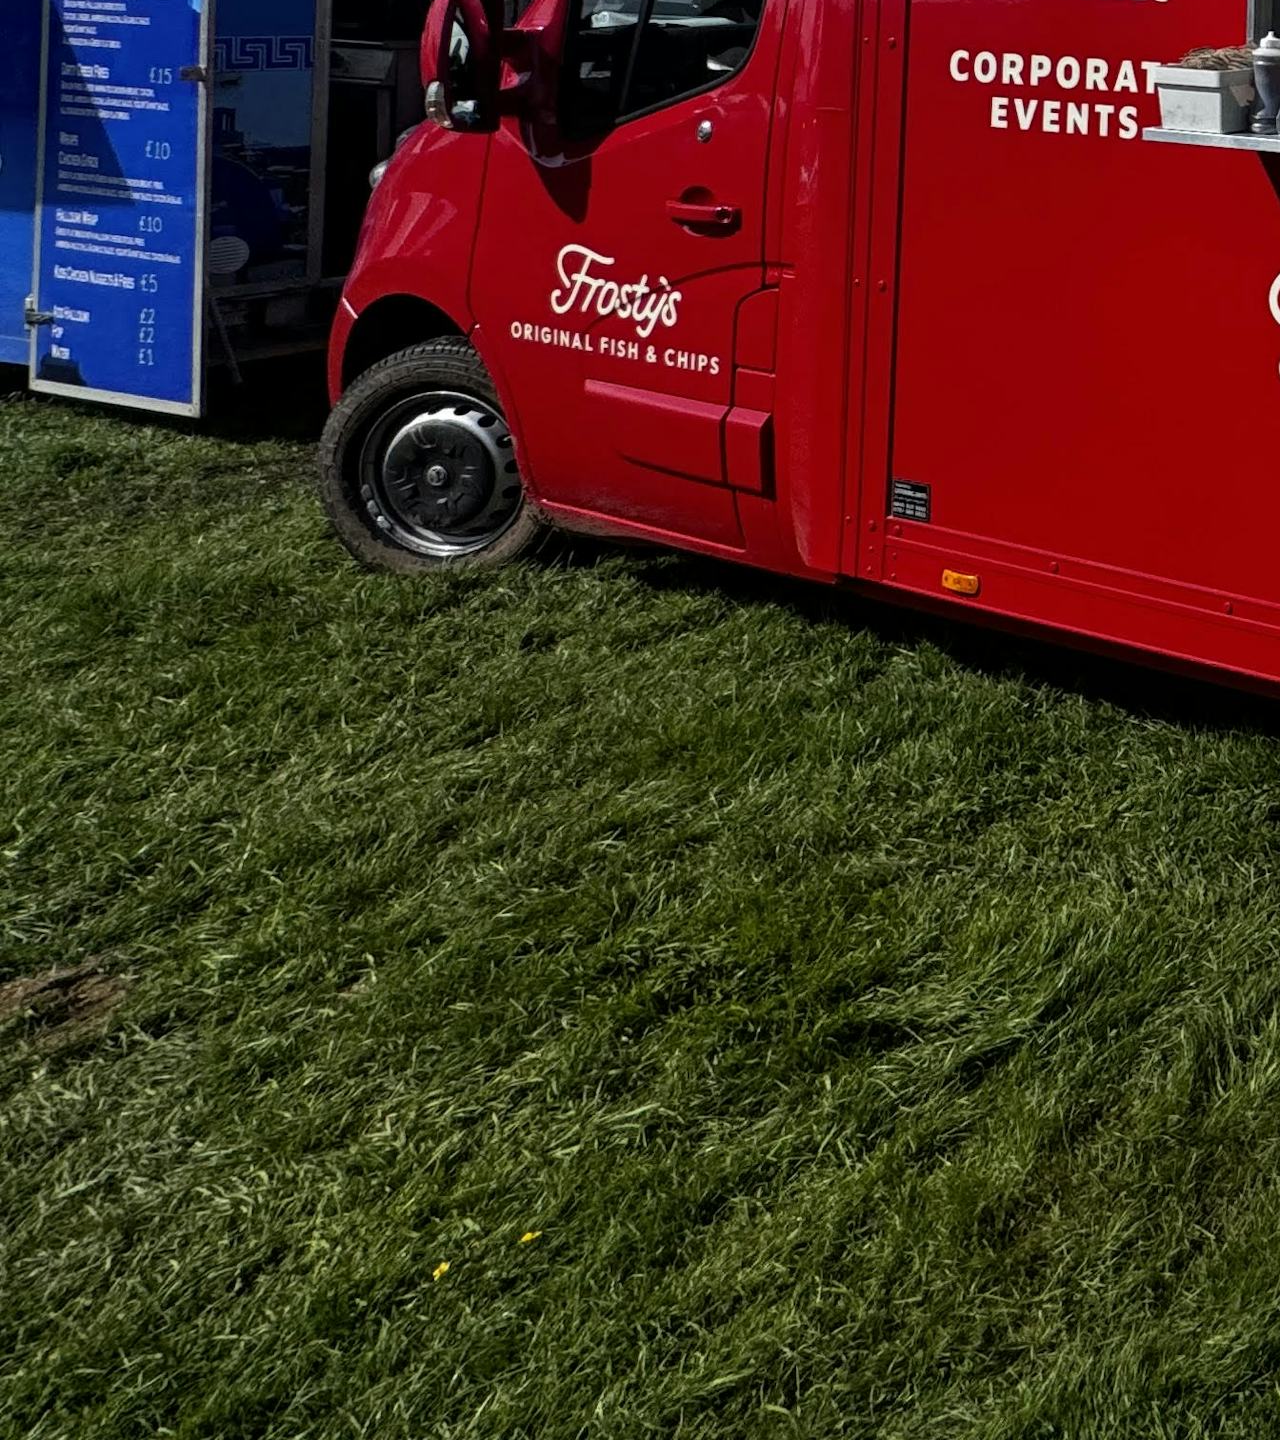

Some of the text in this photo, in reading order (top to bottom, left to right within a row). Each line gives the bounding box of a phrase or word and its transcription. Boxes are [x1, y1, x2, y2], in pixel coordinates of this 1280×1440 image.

[149, 66, 173, 85] £15
[949, 49, 1165, 95] CORPORAT
[990, 96, 1138, 140] EVENTS
[144, 140, 171, 160] £10
[139, 215, 163, 233] £10
[140, 274, 158, 293] £5
[139, 308, 155, 324] £2
[139, 327, 155, 344] £2
[138, 348, 154, 366] £1
[510, 321, 720, 375] ORIGINAL FISH & CHIPS
